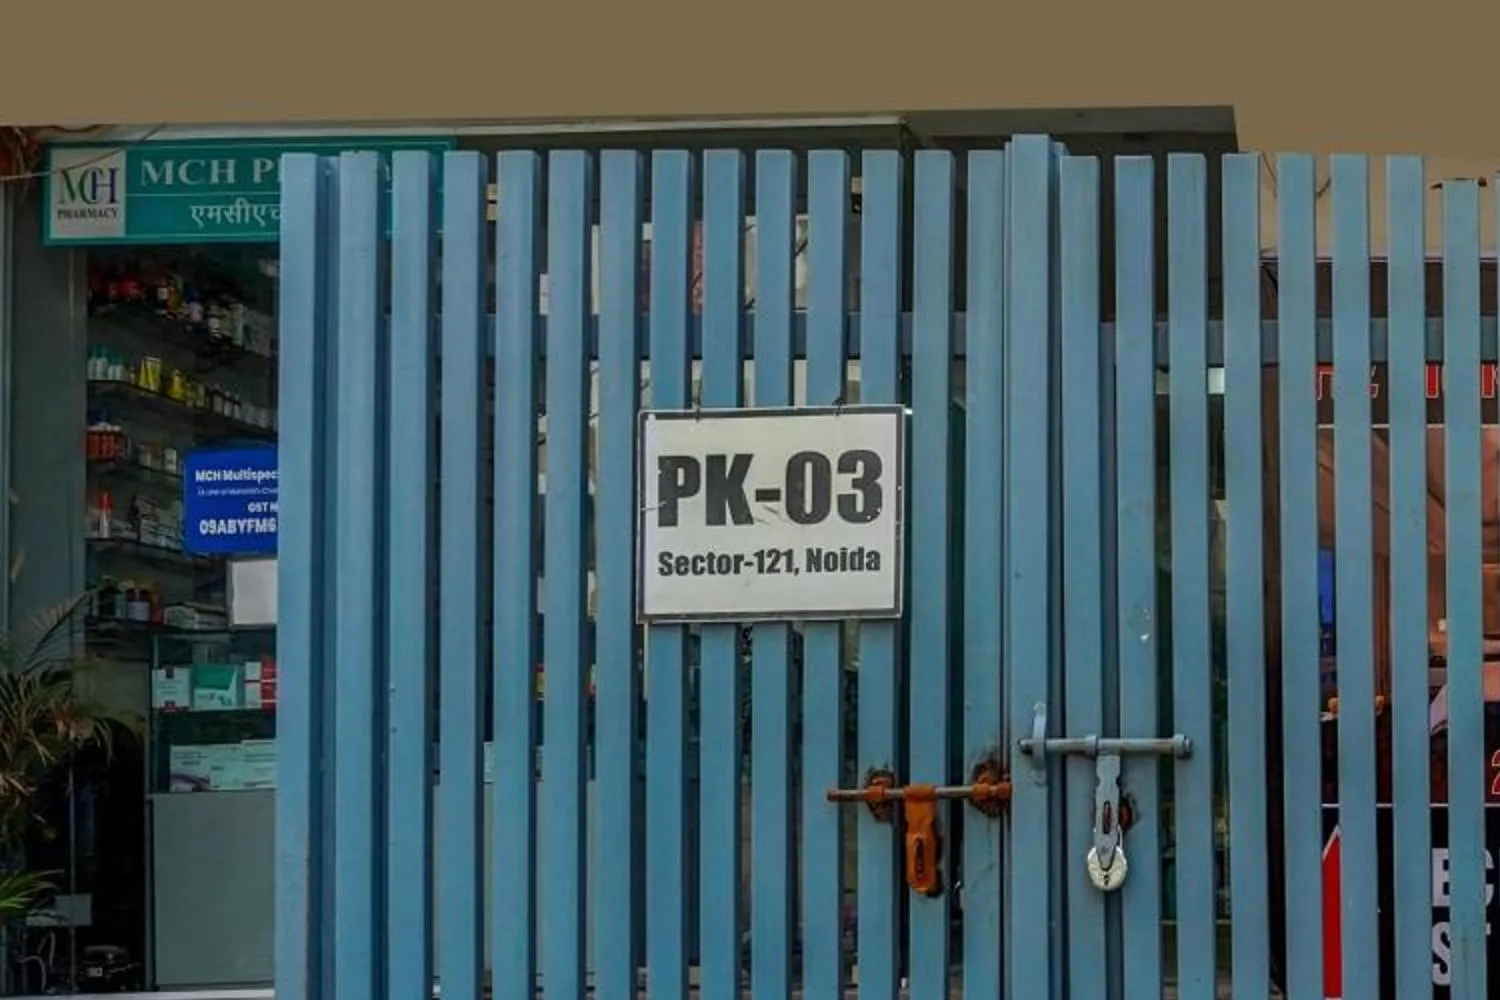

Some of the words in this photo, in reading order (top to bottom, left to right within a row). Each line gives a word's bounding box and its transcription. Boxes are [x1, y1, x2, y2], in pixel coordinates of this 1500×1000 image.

[58, 166, 120, 205] MCH
[141, 157, 236, 187] MCH
[57, 207, 118, 222] PHARMACY
[195, 469, 220, 482] MCH
[657, 449, 883, 528] PK-03
[657, 549, 800, 577] Sector-121,
[805, 547, 881, 574] Noida
